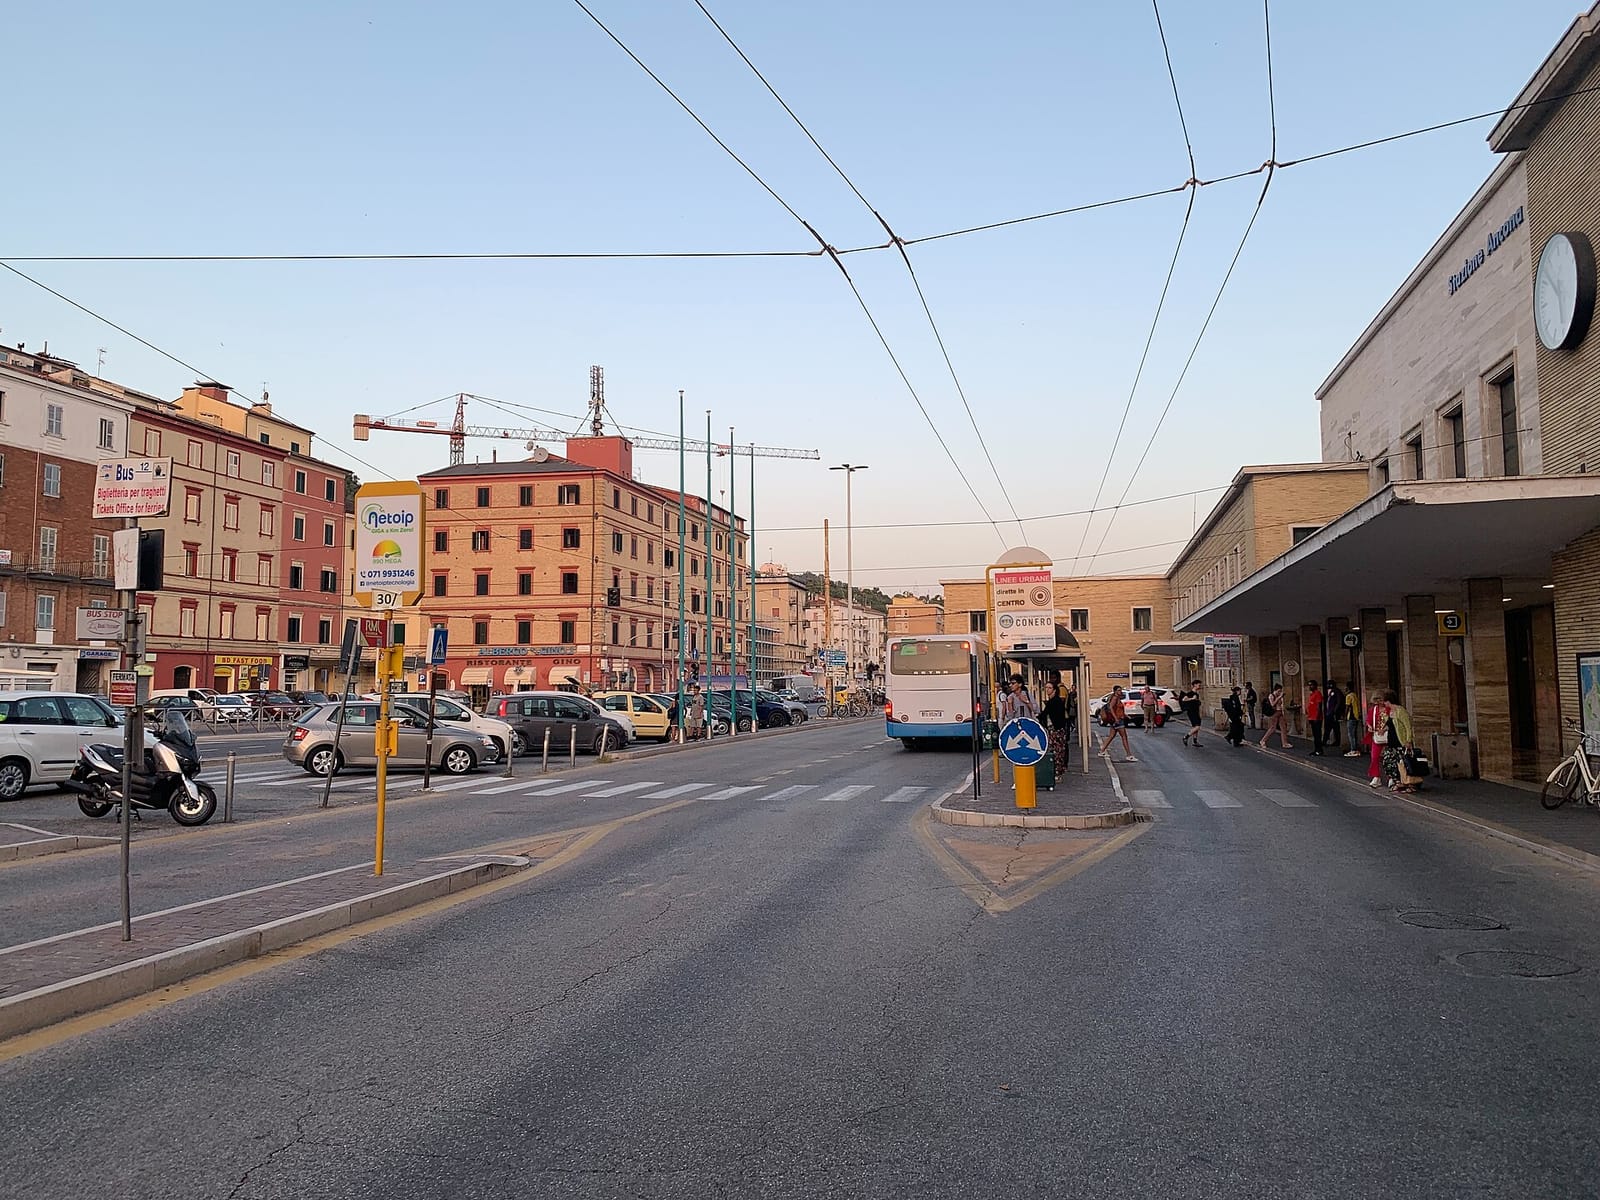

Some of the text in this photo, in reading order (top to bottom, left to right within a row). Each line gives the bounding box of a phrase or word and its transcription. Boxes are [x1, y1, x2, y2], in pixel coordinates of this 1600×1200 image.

[1448, 206, 1524, 295] Stazione Ancona
[116, 462, 149, 480] Bus 12
[97, 485, 166, 500] Biglietteria per traghetti
[96, 504, 114, 514] Tickets
[116, 502, 134, 513] Office
[135, 502, 144, 513] for
[382, 569, 415, 578] 9931246
[996, 574, 1050, 584] LINEE URBANE
[86, 610, 123, 618] BUS STOP
[1016, 618, 1052, 627] CONERO
